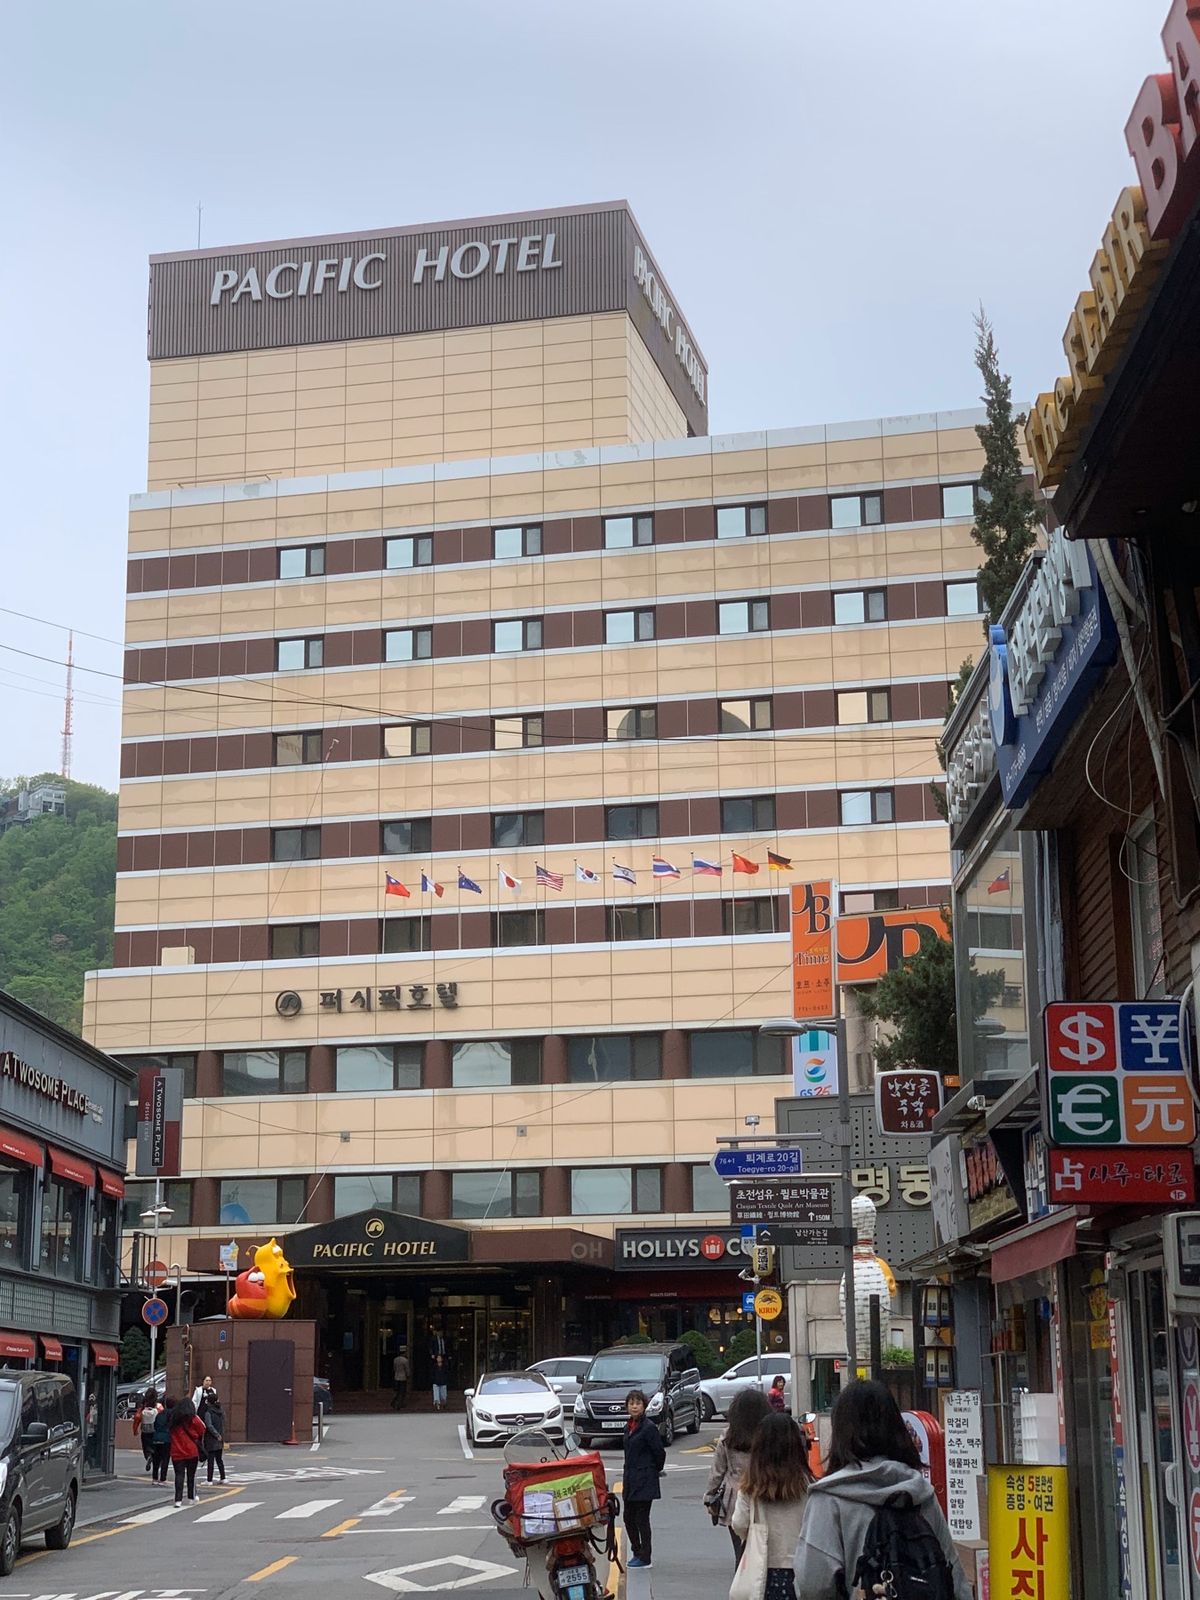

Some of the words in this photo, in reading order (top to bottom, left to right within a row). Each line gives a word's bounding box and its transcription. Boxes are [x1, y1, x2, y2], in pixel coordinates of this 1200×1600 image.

[210, 253, 387, 306] PACIFIC
[412, 233, 563, 284] HOTEL
[634, 246, 675, 342] PACIFIC
[675, 326, 706, 407] HOTEL
[320, 982, 458, 1013] 퍼시픽호텔
[1059, 1011, 1106, 1065] $
[1131, 1014, 1179, 1064] ¥
[3, 1053, 11, 1075] A
[12, 1055, 60, 1099] TWOSOME
[61, 1080, 90, 1115] PLACE
[155, 1088, 163, 1132] TWOSOME
[1057, 1083, 1113, 1136] €
[1131, 1086, 1185, 1132] 元
[154, 1134, 162, 1164] PLACE
[737, 1165, 776, 1174] Toegye-ro
[777, 1164, 799, 1173] 20-gil
[1055, 1158, 1084, 1191] 占
[312, 1243, 375, 1257] PACIFIC
[383, 1241, 437, 1256] HOTEL
[623, 1239, 700, 1258] HOLLYS
[947, 1418, 969, 1428] 막걸리
[1006, 1475, 1025, 1491] 속성
